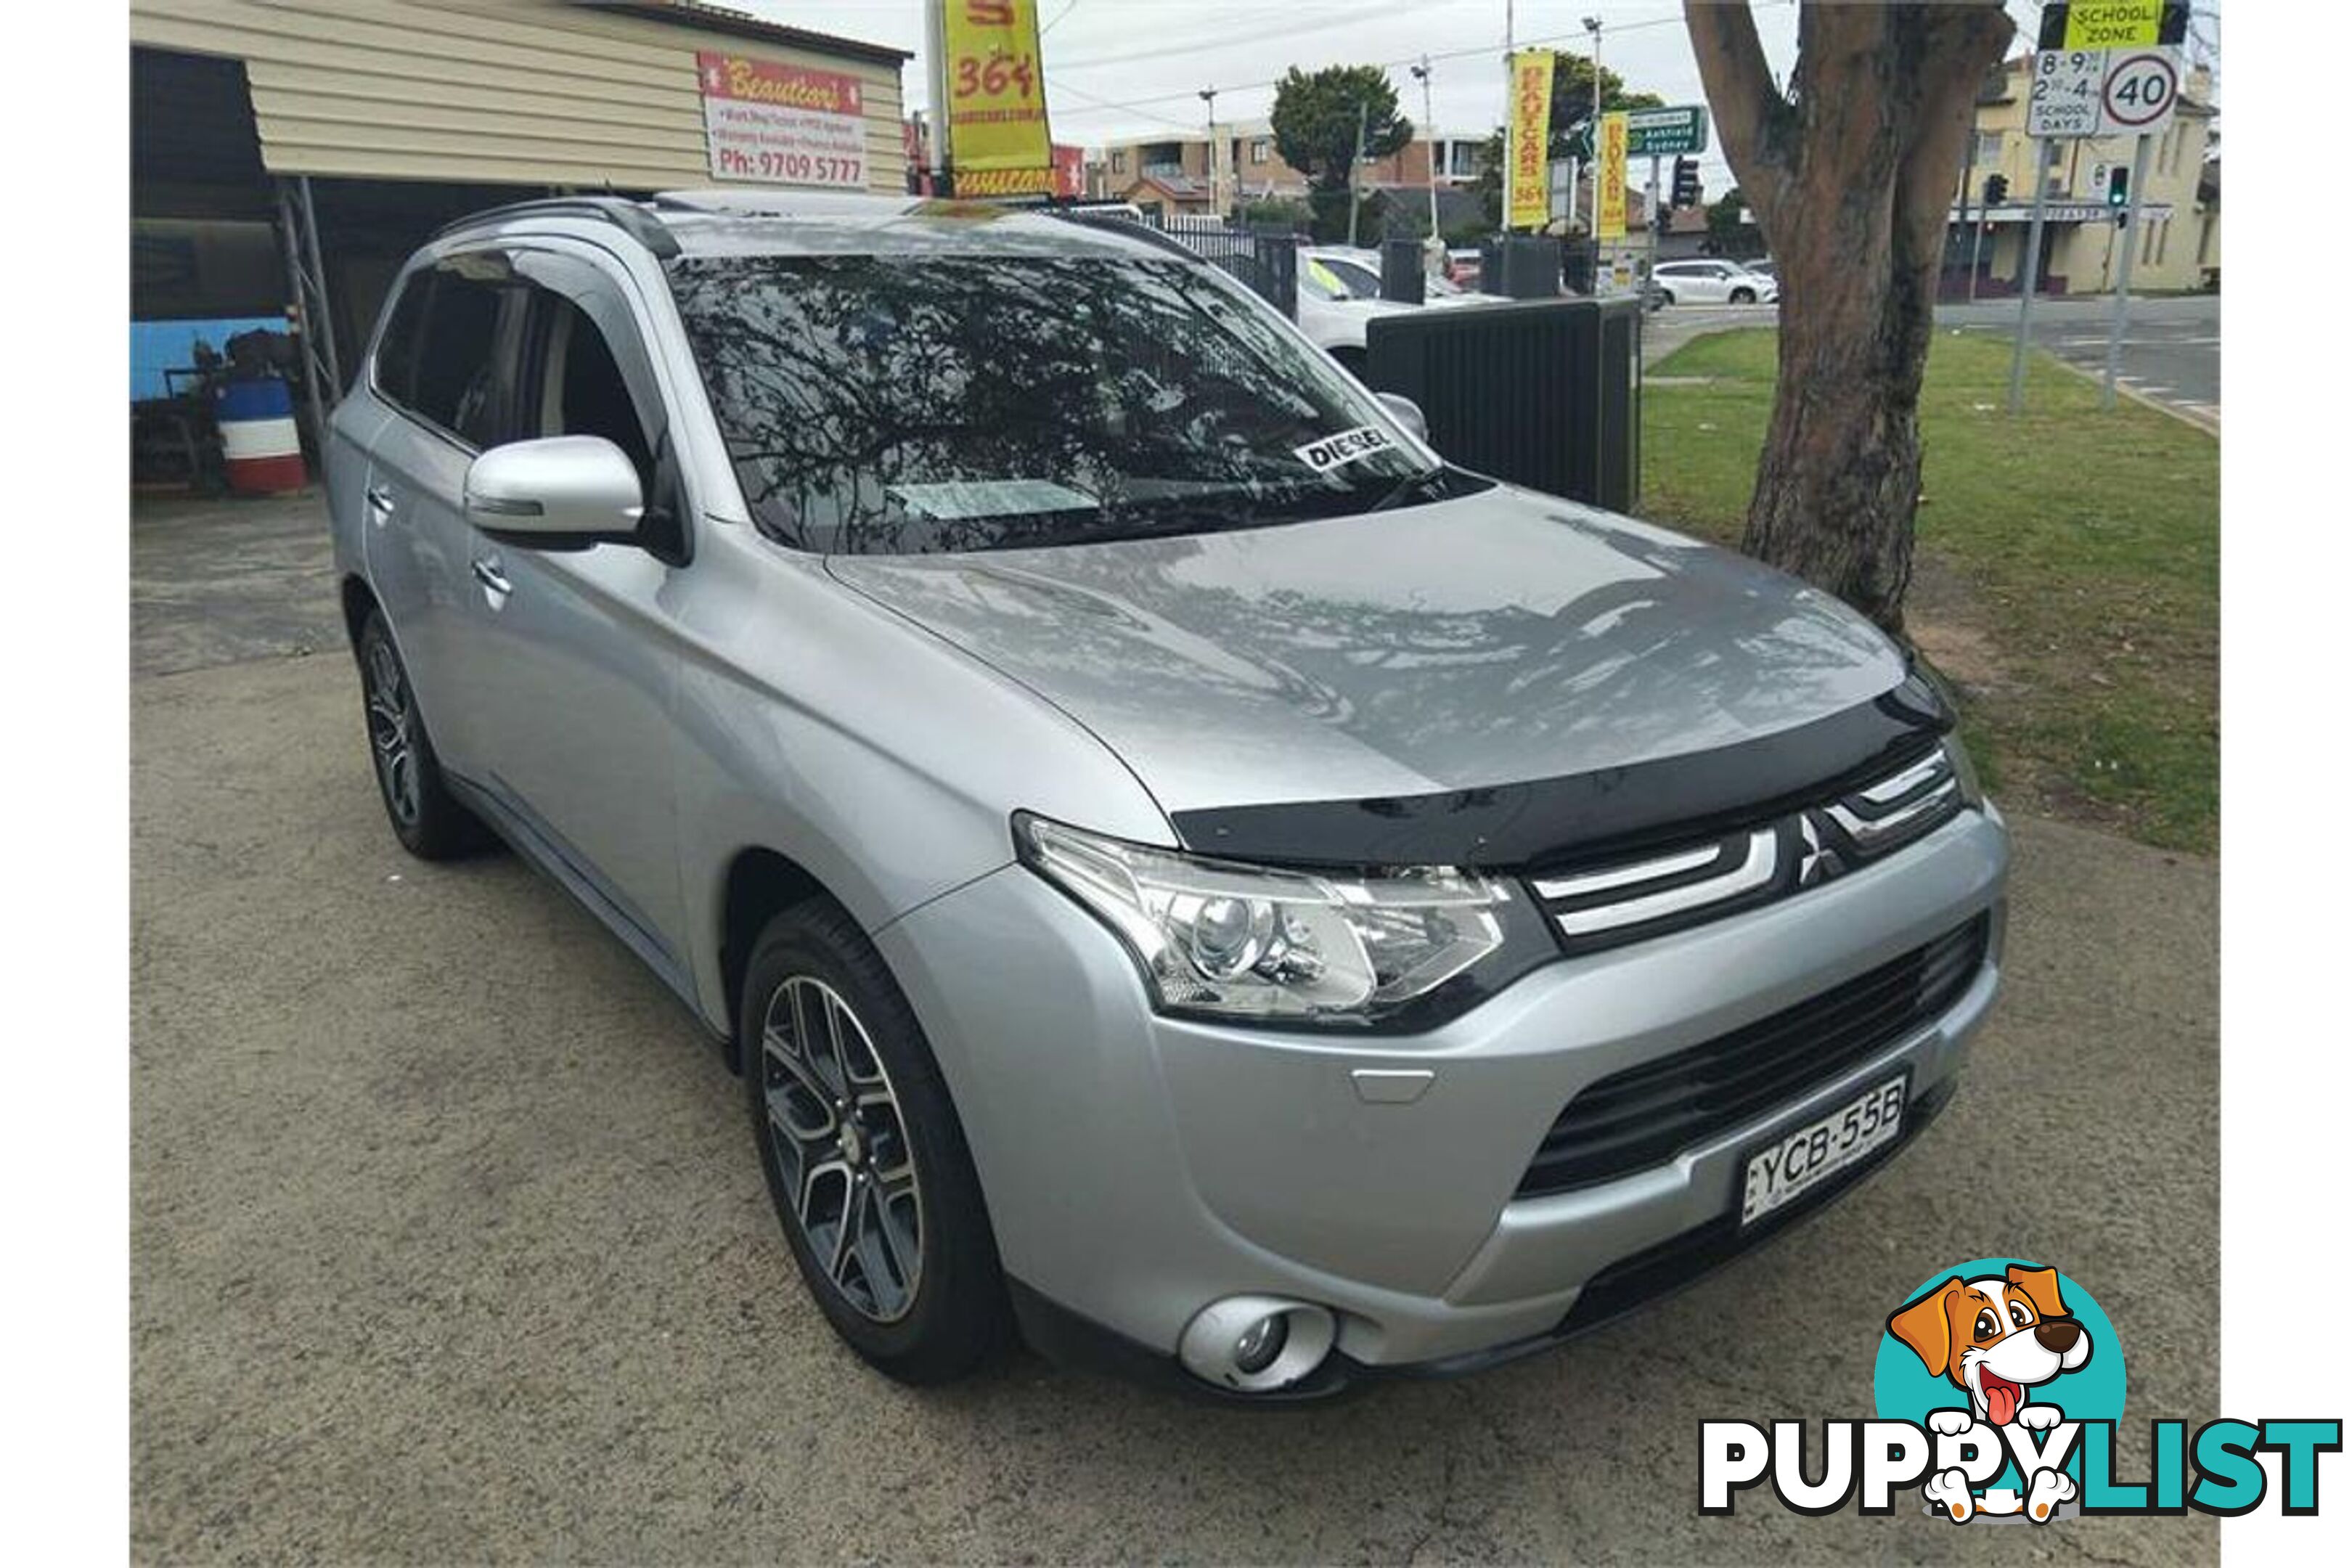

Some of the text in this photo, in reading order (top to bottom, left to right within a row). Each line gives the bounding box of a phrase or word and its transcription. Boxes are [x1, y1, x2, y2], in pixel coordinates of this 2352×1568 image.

[2078, 7, 2151, 24] SCHOOL
[2087, 26, 2136, 42] ZONE
[2116, 75, 2165, 105] 40
[2035, 103, 2088, 116] SCHOOL
[2041, 118, 2083, 131] DAYS
[1646, 139, 1689, 153] Sydney
[759, 151, 812, 179] 9709
[817, 156, 862, 182] 5777
[1308, 428, 1390, 467] DIESEL
